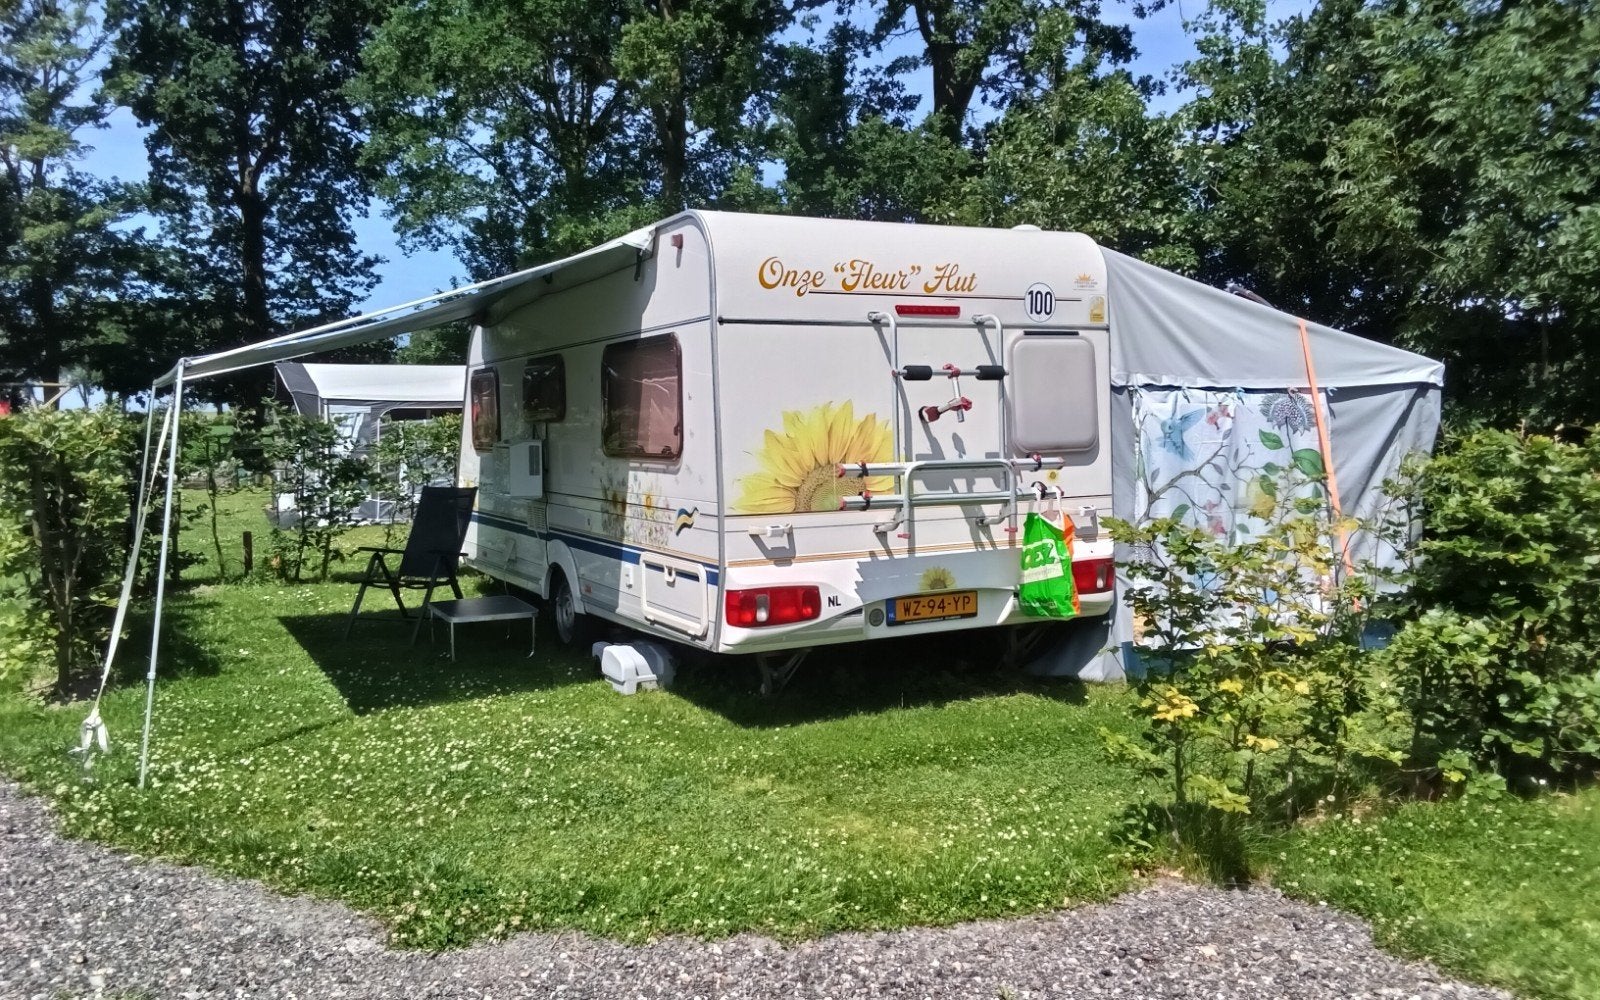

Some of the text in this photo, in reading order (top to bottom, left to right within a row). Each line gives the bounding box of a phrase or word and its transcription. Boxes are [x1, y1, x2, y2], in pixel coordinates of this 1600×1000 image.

[758, 256, 826, 297] Onze
[923, 262, 978, 294] Hut
[1028, 290, 1053, 315] 100
[827, 595, 841, 607] NL
[903, 596, 971, 617] WZ-94-YP
